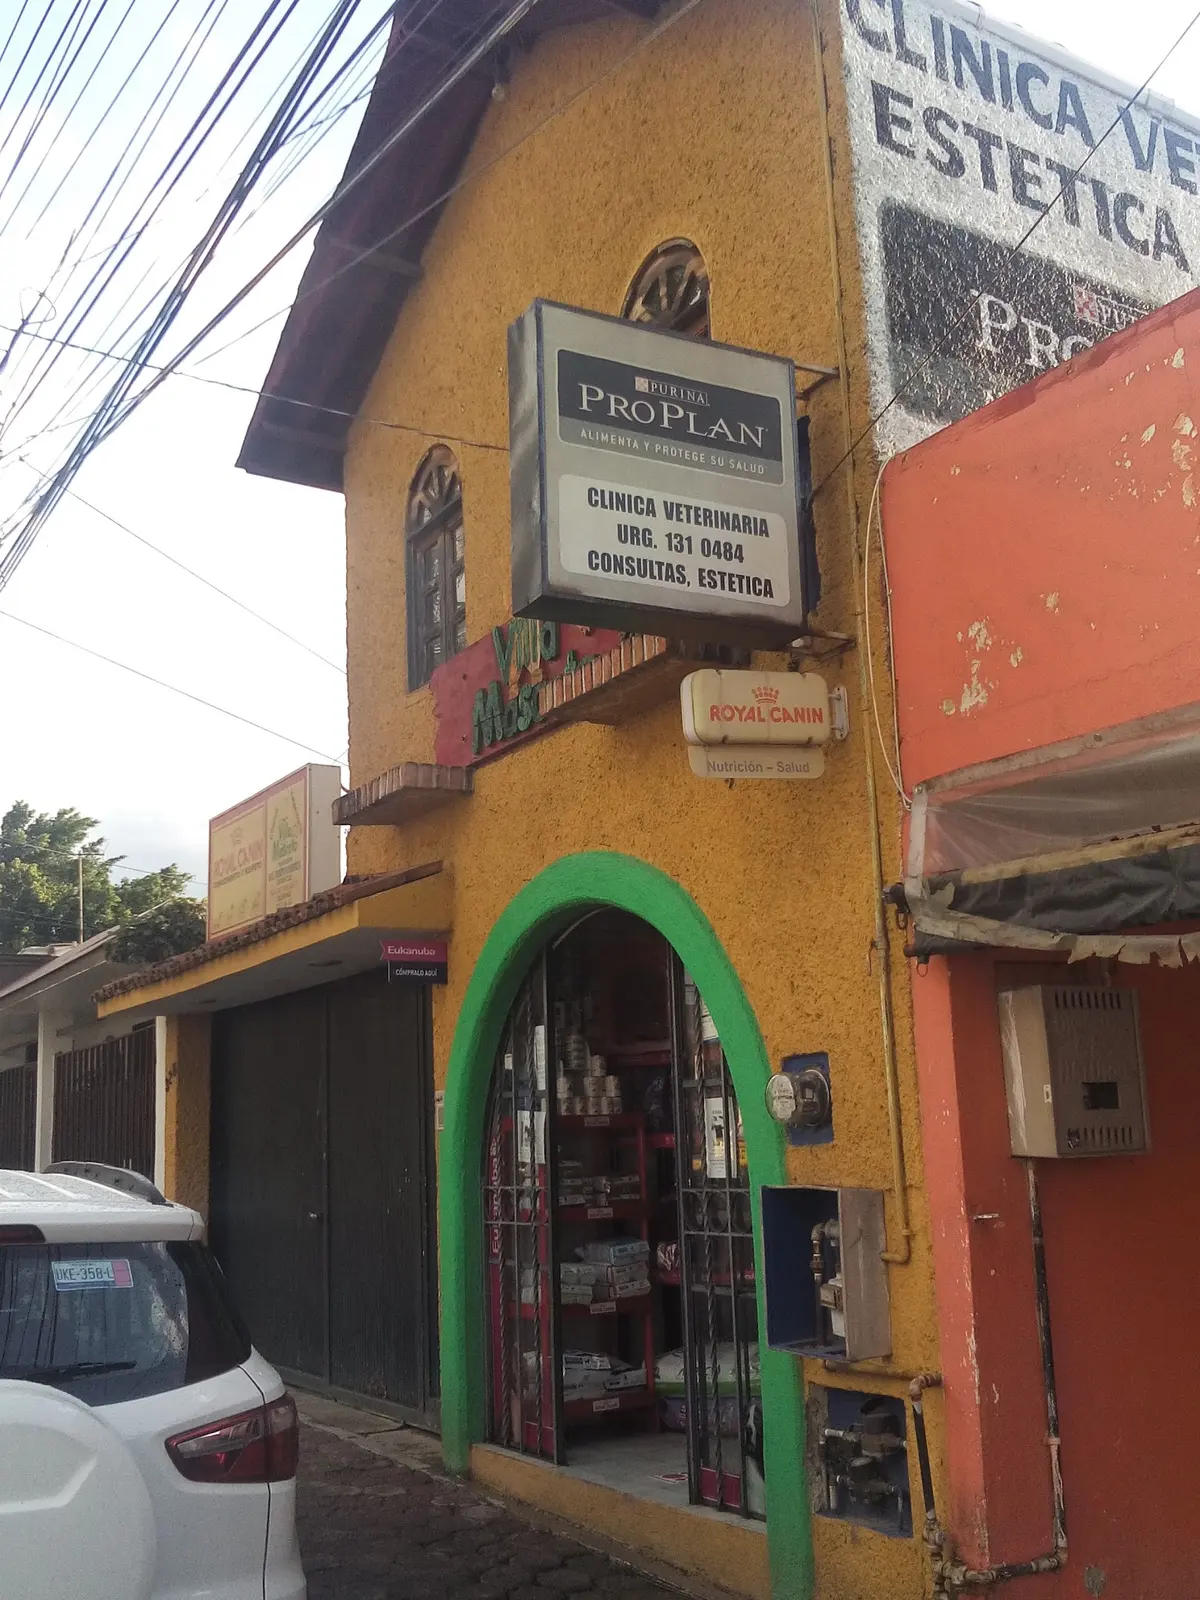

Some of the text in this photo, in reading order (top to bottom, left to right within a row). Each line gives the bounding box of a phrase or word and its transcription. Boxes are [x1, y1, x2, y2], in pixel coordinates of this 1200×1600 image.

[846, 0, 1200, 195] CLINICA VE
[871, 80, 1192, 277] ESTETICA
[650, 382, 706, 405] PURINA
[580, 428, 765, 476] ALIMENTA Y PROTEGE SU SALUD
[587, 487, 770, 538] CLINICA VETERINARIA
[617, 523, 744, 564] URG. 131 0484
[587, 549, 774, 599] CONSULTAS, ESTETICA
[709, 704, 824, 724] ROYAL CANIN
[708, 760, 763, 773] Nutrición
[777, 761, 810, 773] Salud
[387, 945, 436, 956] Eukanuba
[395, 966, 438, 977] CÓMPRALO AQUÍ
[55, 1267, 114, 1281] UKE-358-L
